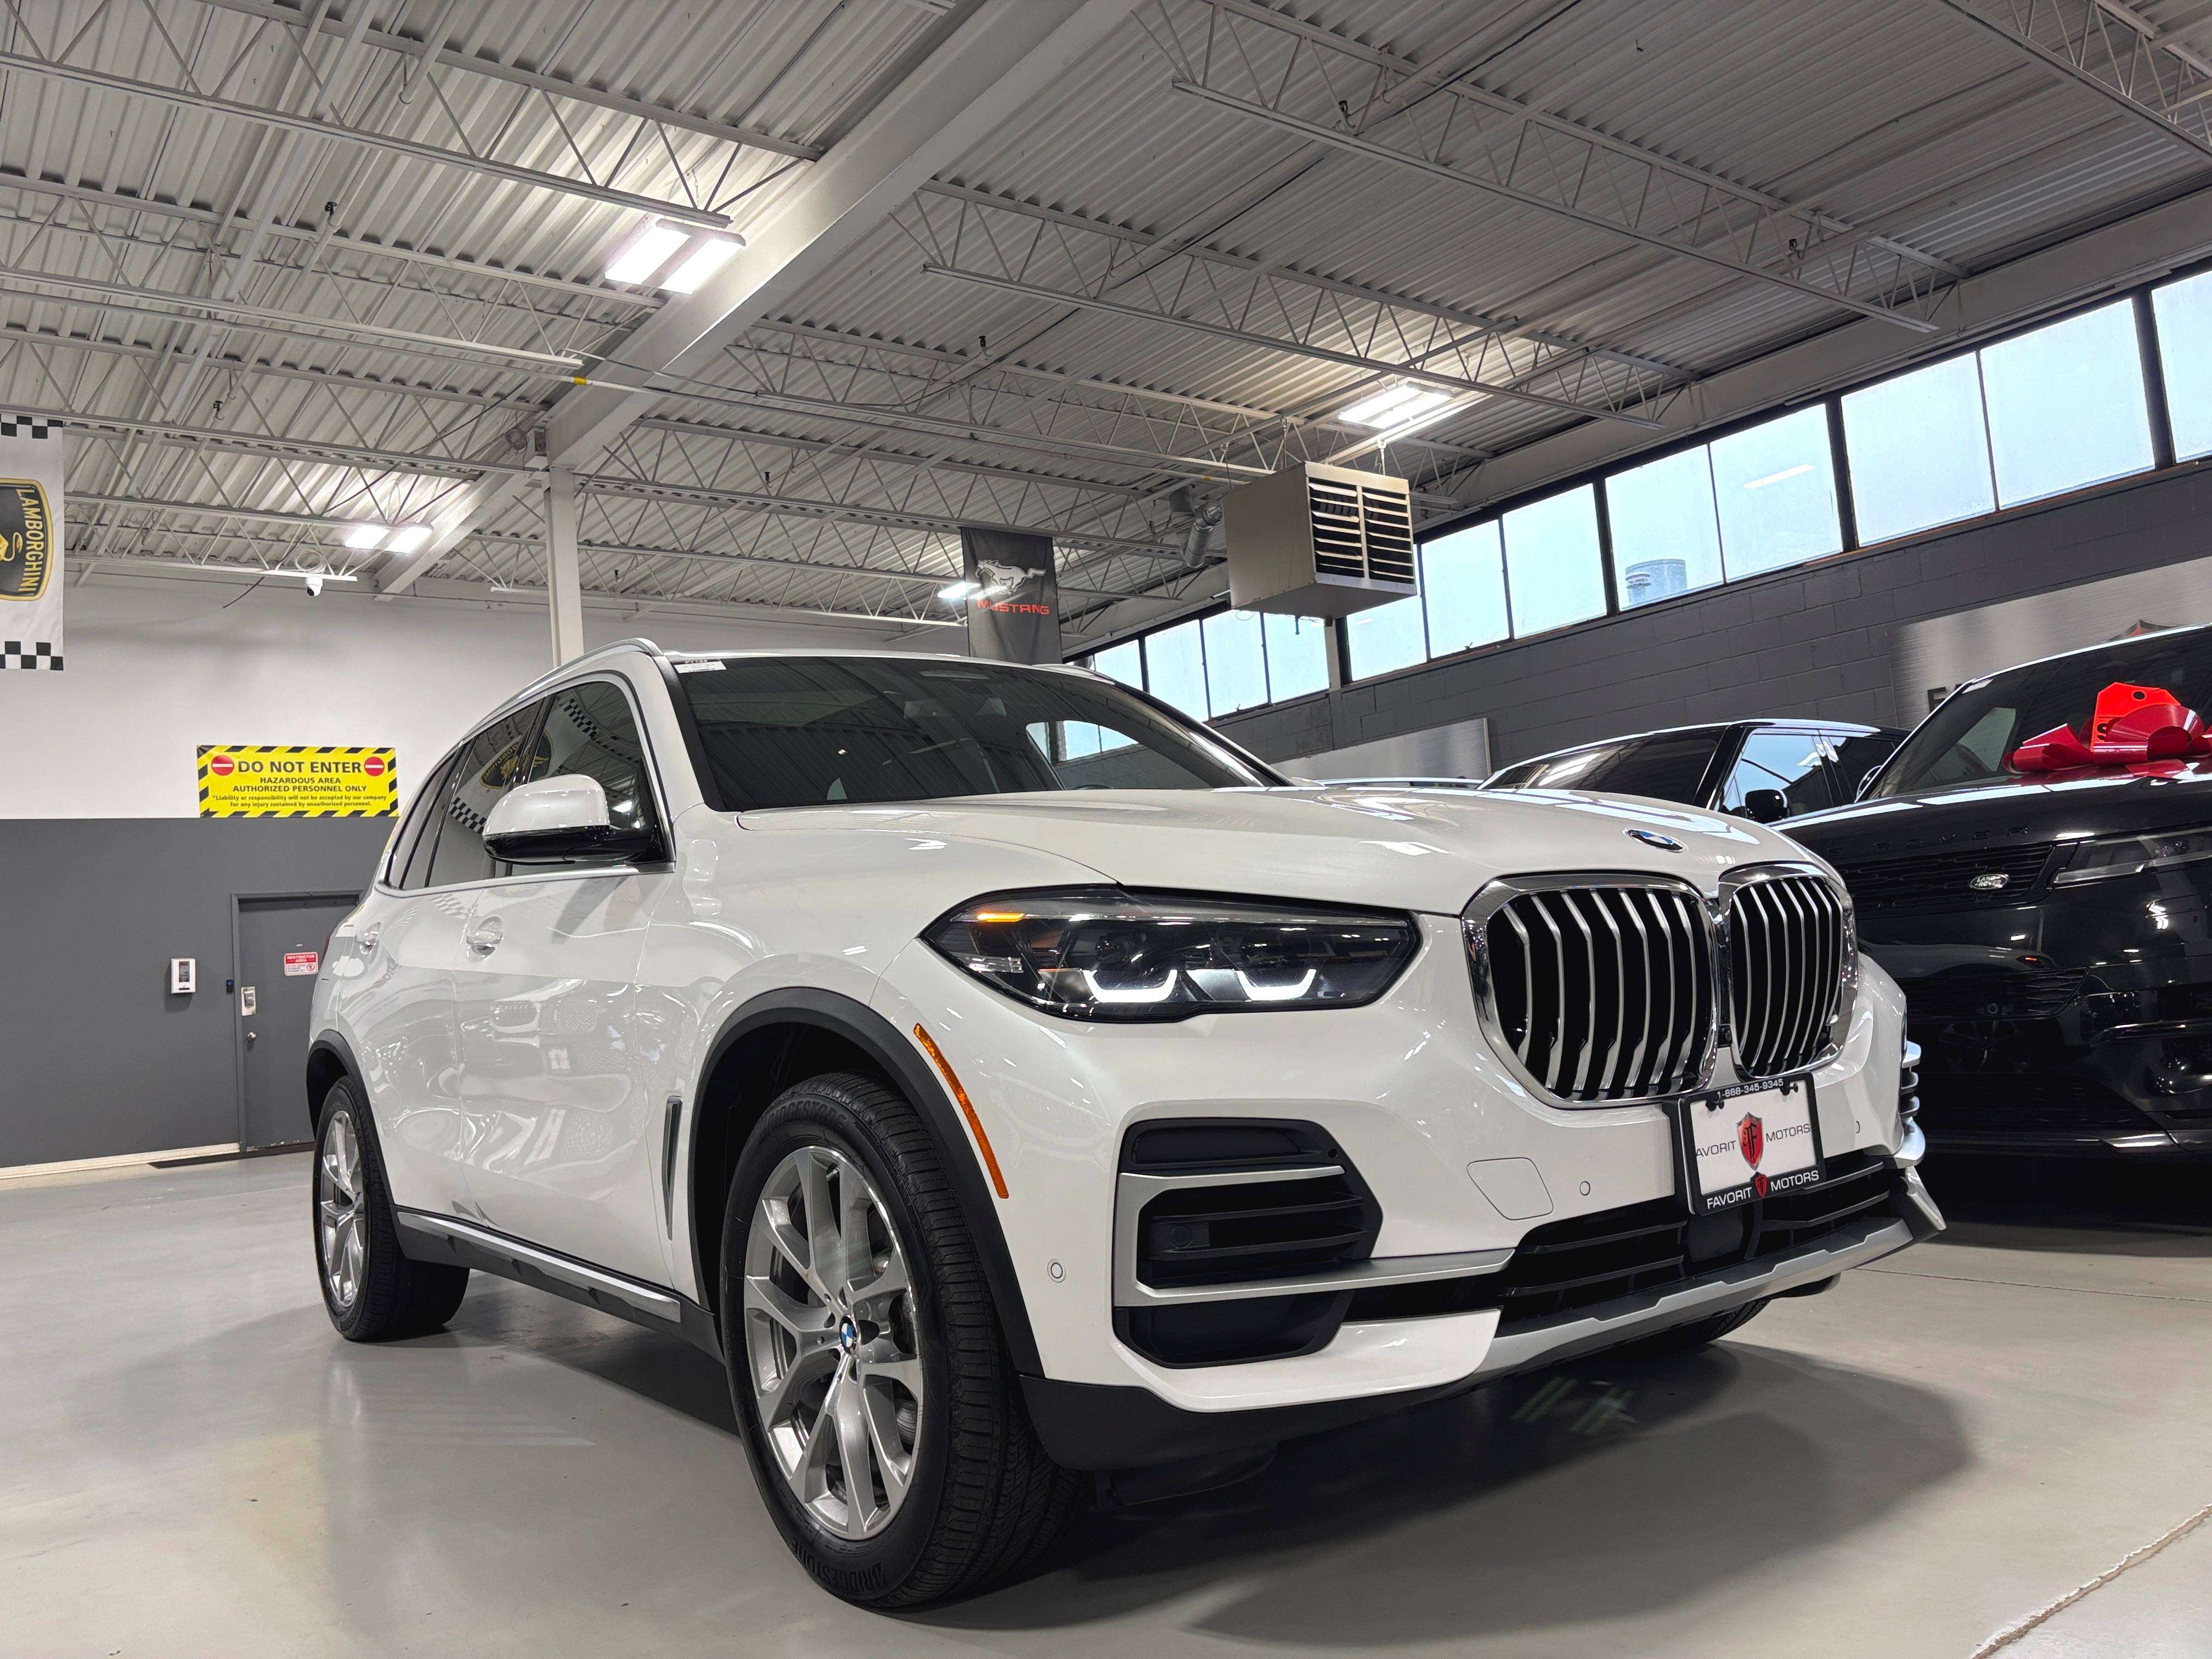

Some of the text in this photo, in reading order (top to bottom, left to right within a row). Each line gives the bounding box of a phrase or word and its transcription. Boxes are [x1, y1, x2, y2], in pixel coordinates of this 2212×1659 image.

[16, 487, 44, 592] LAMBORGHINI
[977, 599, 1049, 615] MUSTANG
[238, 761, 362, 773] DO NOT ENTER
[1717, 1078, 1784, 1098] 1-888-345-9345
[1765, 1123, 1810, 1142] MOTORS
[1707, 1187, 1752, 1209] FAVORIT
[1770, 1170, 1819, 1192] MOTORS
